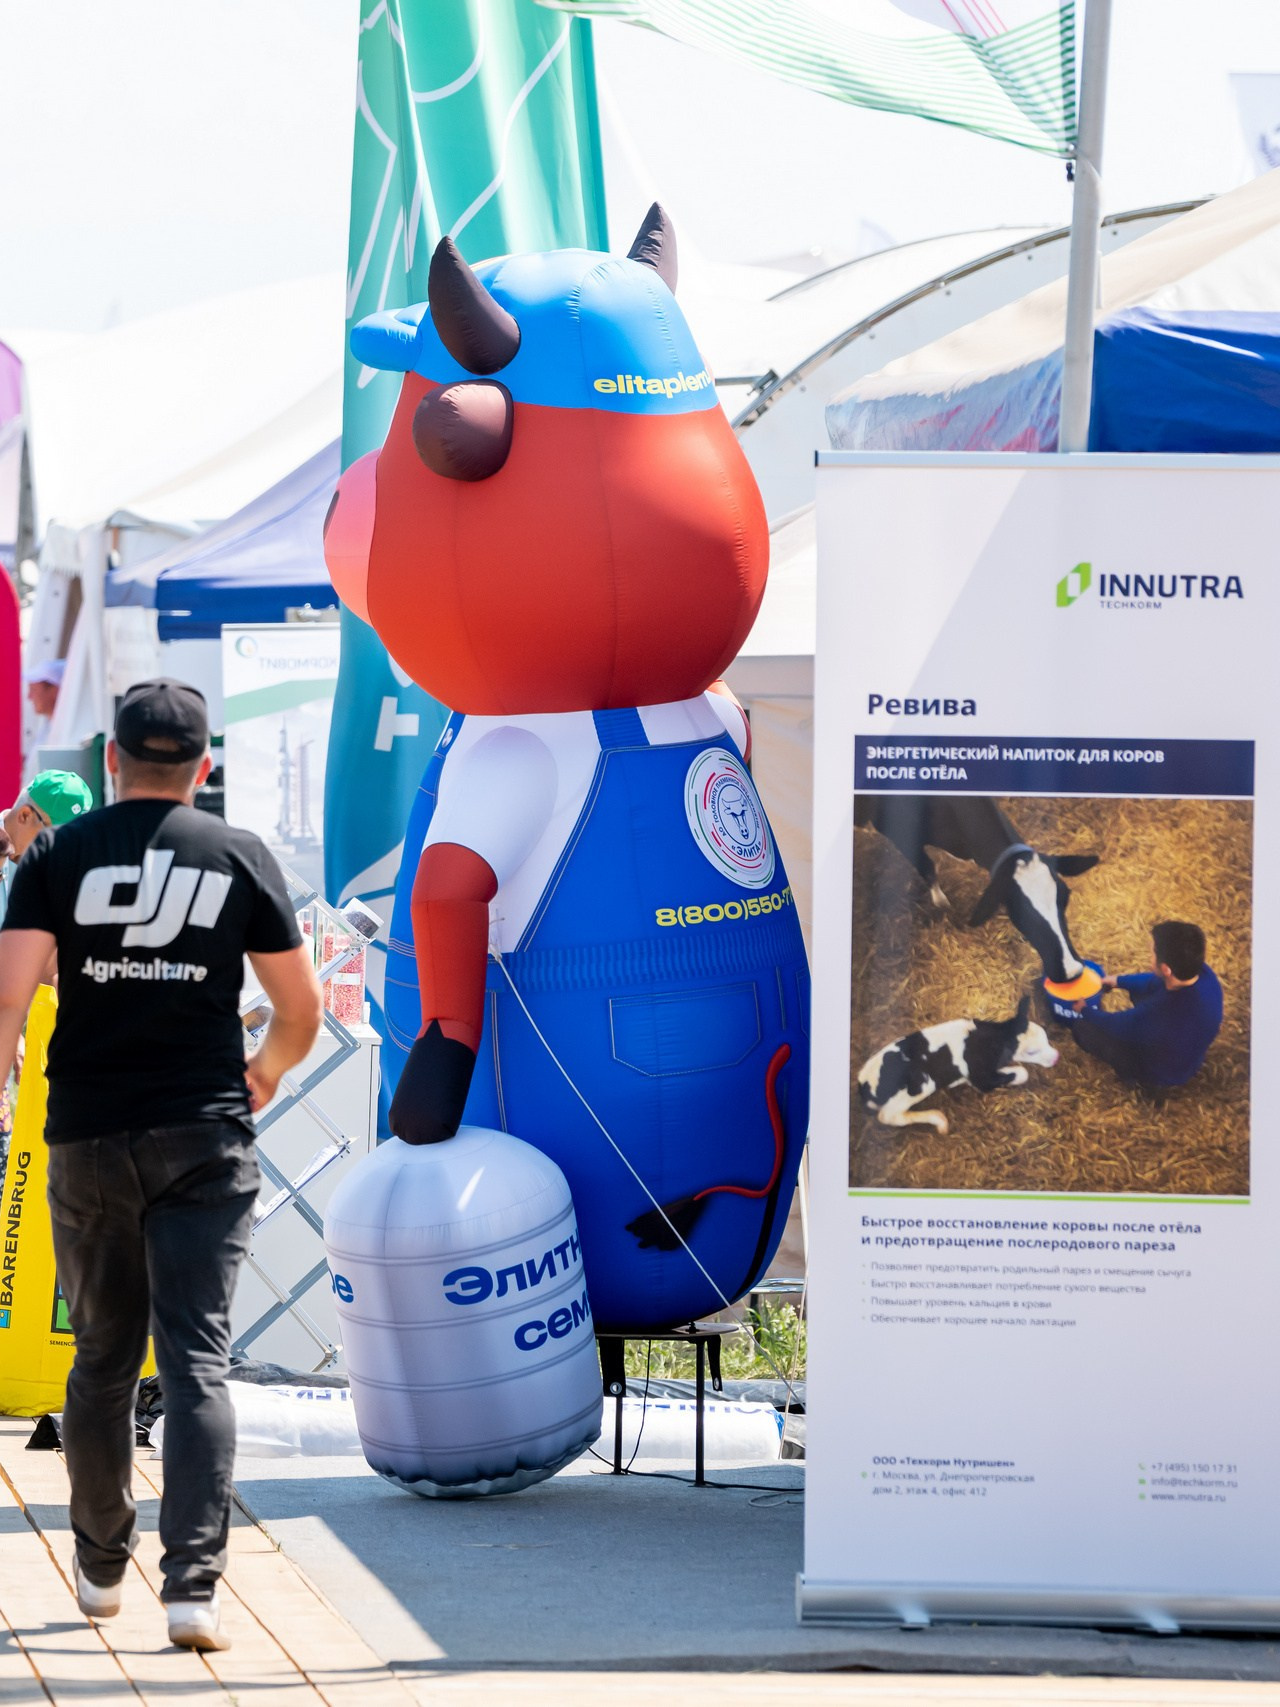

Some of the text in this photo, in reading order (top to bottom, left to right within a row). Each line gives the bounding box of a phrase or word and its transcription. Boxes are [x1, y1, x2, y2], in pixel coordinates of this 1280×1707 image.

[1099, 573, 1244, 599] INNUTRA
[1100, 601, 1163, 610] TECHKORM
[867, 693, 977, 717] Ревива
[866, 744, 1164, 765] ЭНЕРГЕТИЧЕСКИЙ НАПИТОК ДЛЯ КОРОВ
[866, 763, 968, 781] ПОСЛЕ ОТЁЛА
[81, 956, 208, 984] Agriculture
[0, 1151, 31, 1307] BARENBRUG
[861, 1215, 1202, 1234] Быстрое восстановление коровы после отёла
[861, 1236, 1176, 1253] и предотвращение послеродового пареза
[926, 1263, 1000, 1273] предотвратить
[871, 1279, 907, 1289] Быстро
[909, 1280, 993, 1290] восстанавливает
[995, 1281, 1061, 1291] потребление
[873, 1456, 897, 1465] ООО
[1165, 1463, 1190, 1473] (495)
